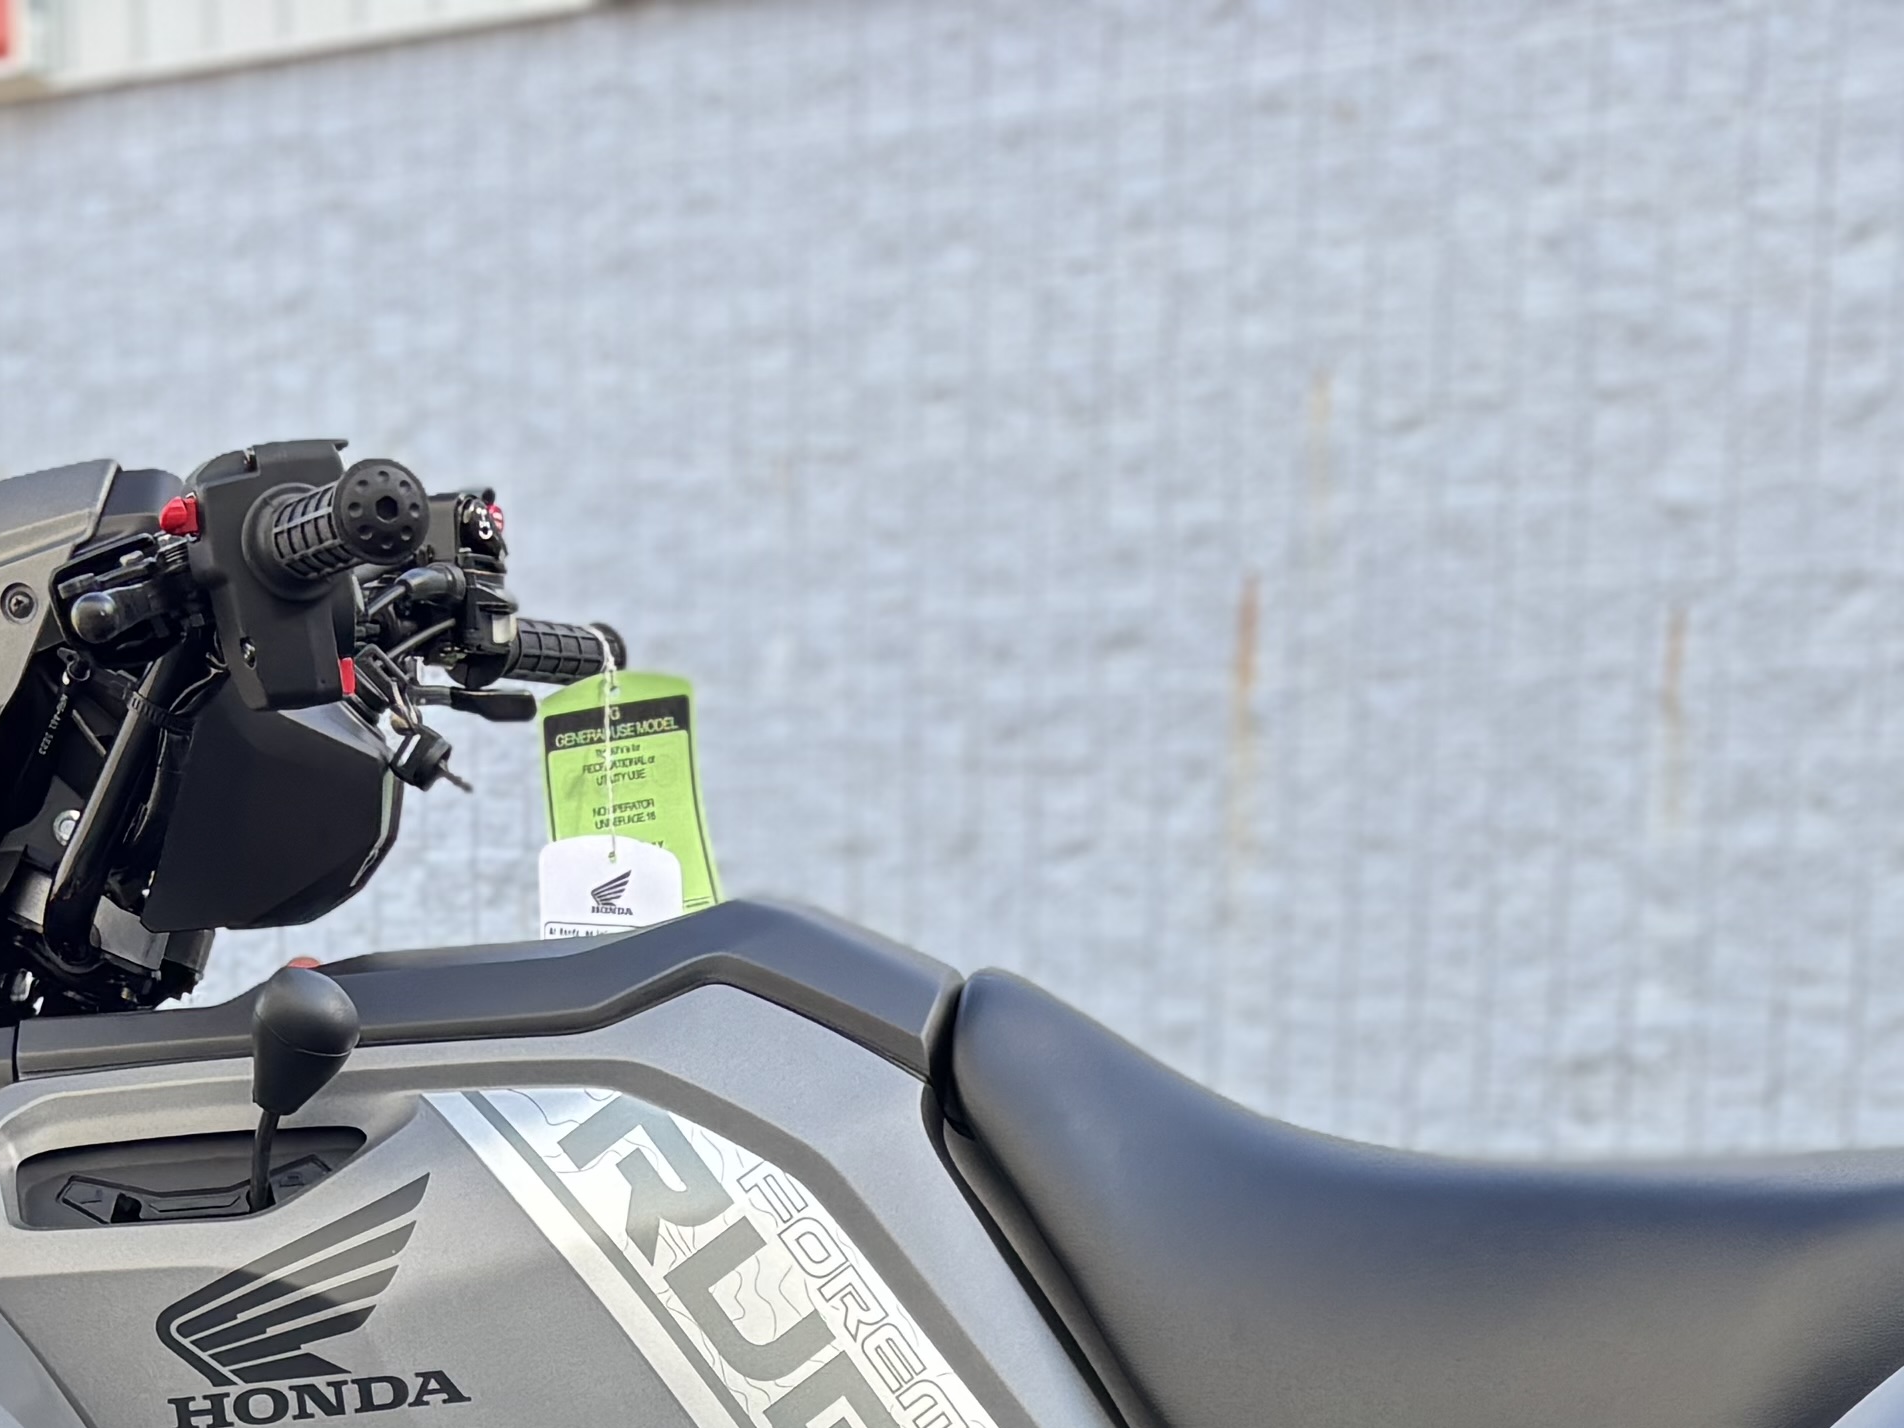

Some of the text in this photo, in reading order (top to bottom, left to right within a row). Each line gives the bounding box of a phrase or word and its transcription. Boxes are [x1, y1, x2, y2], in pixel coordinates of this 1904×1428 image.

[612, 722, 635, 738] USE
[636, 717, 679, 734] MODEL
[582, 757, 647, 774] RECRATIONAL
[591, 905, 634, 916] HONDA
